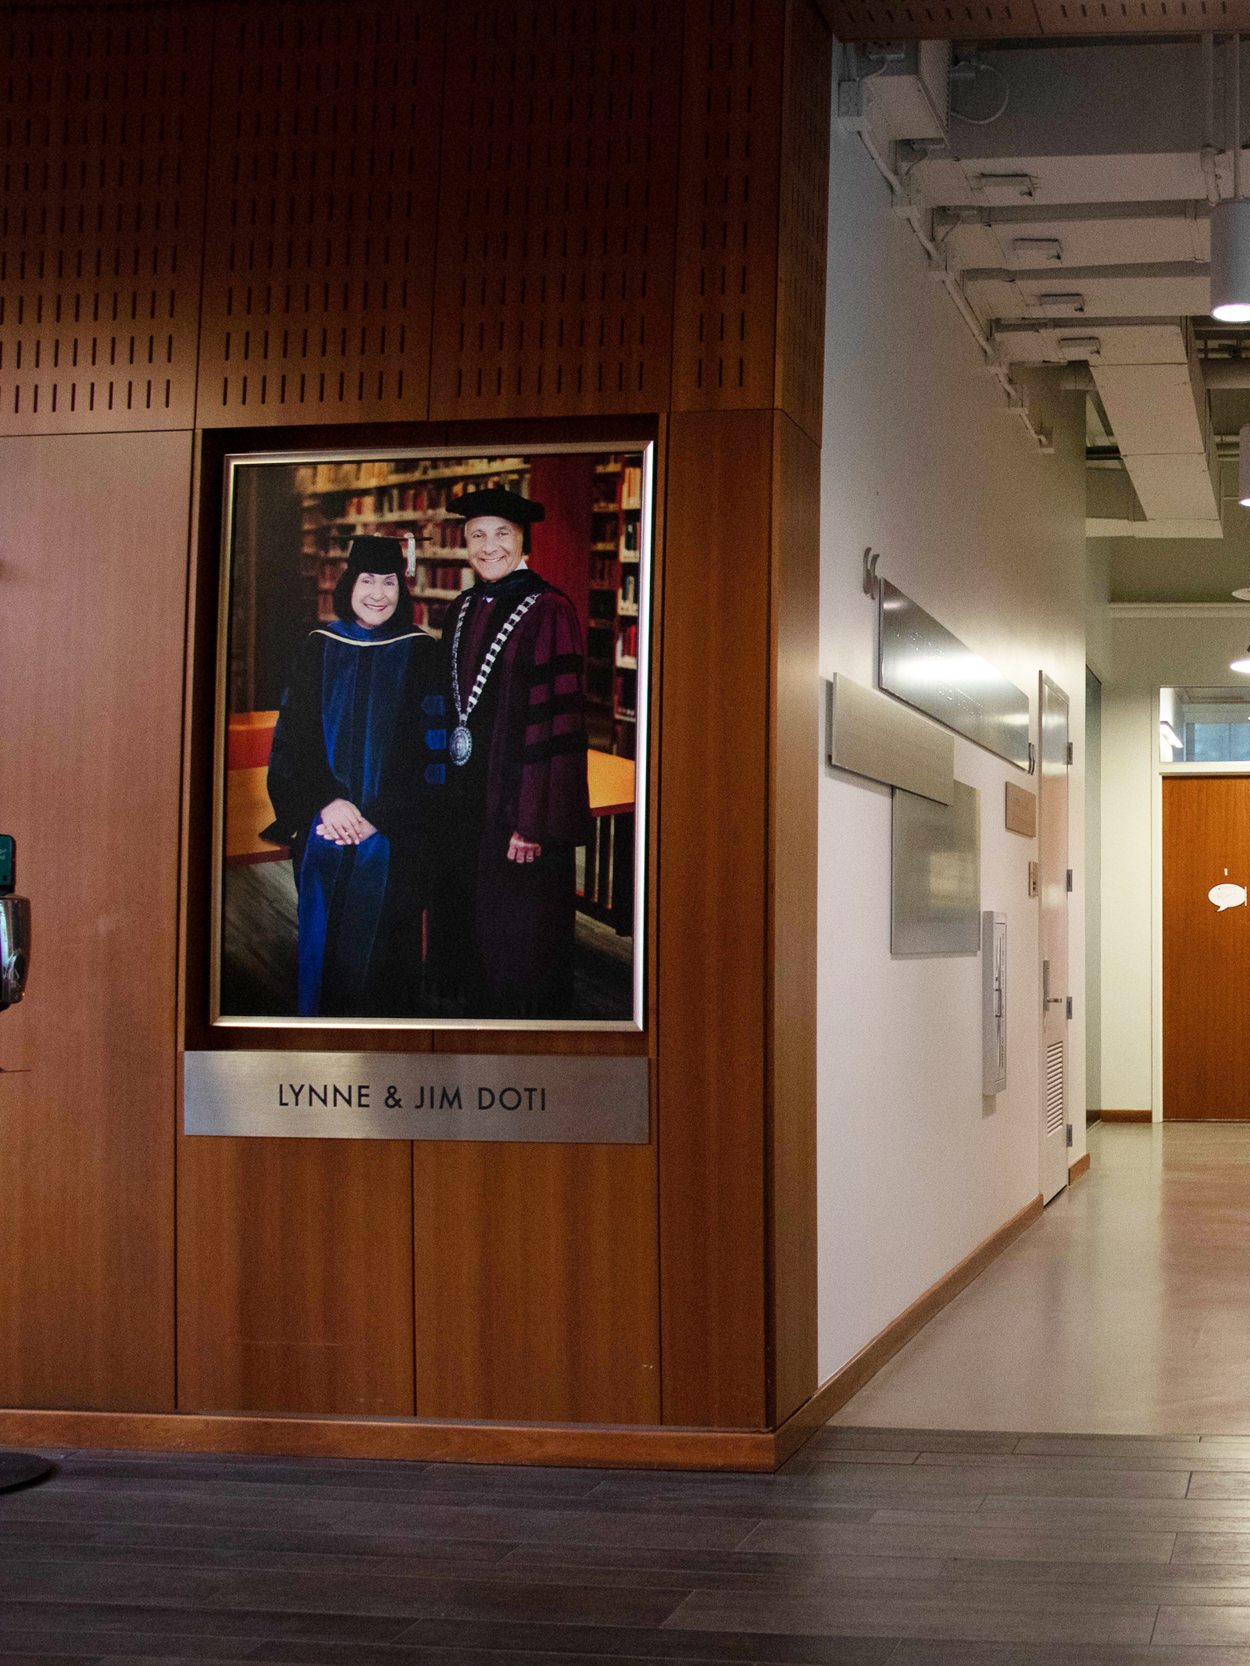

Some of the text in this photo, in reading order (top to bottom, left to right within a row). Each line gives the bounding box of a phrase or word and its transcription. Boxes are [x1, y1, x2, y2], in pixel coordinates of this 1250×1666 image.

[278, 1083, 547, 1112] LYNNE & JIM DOTI
